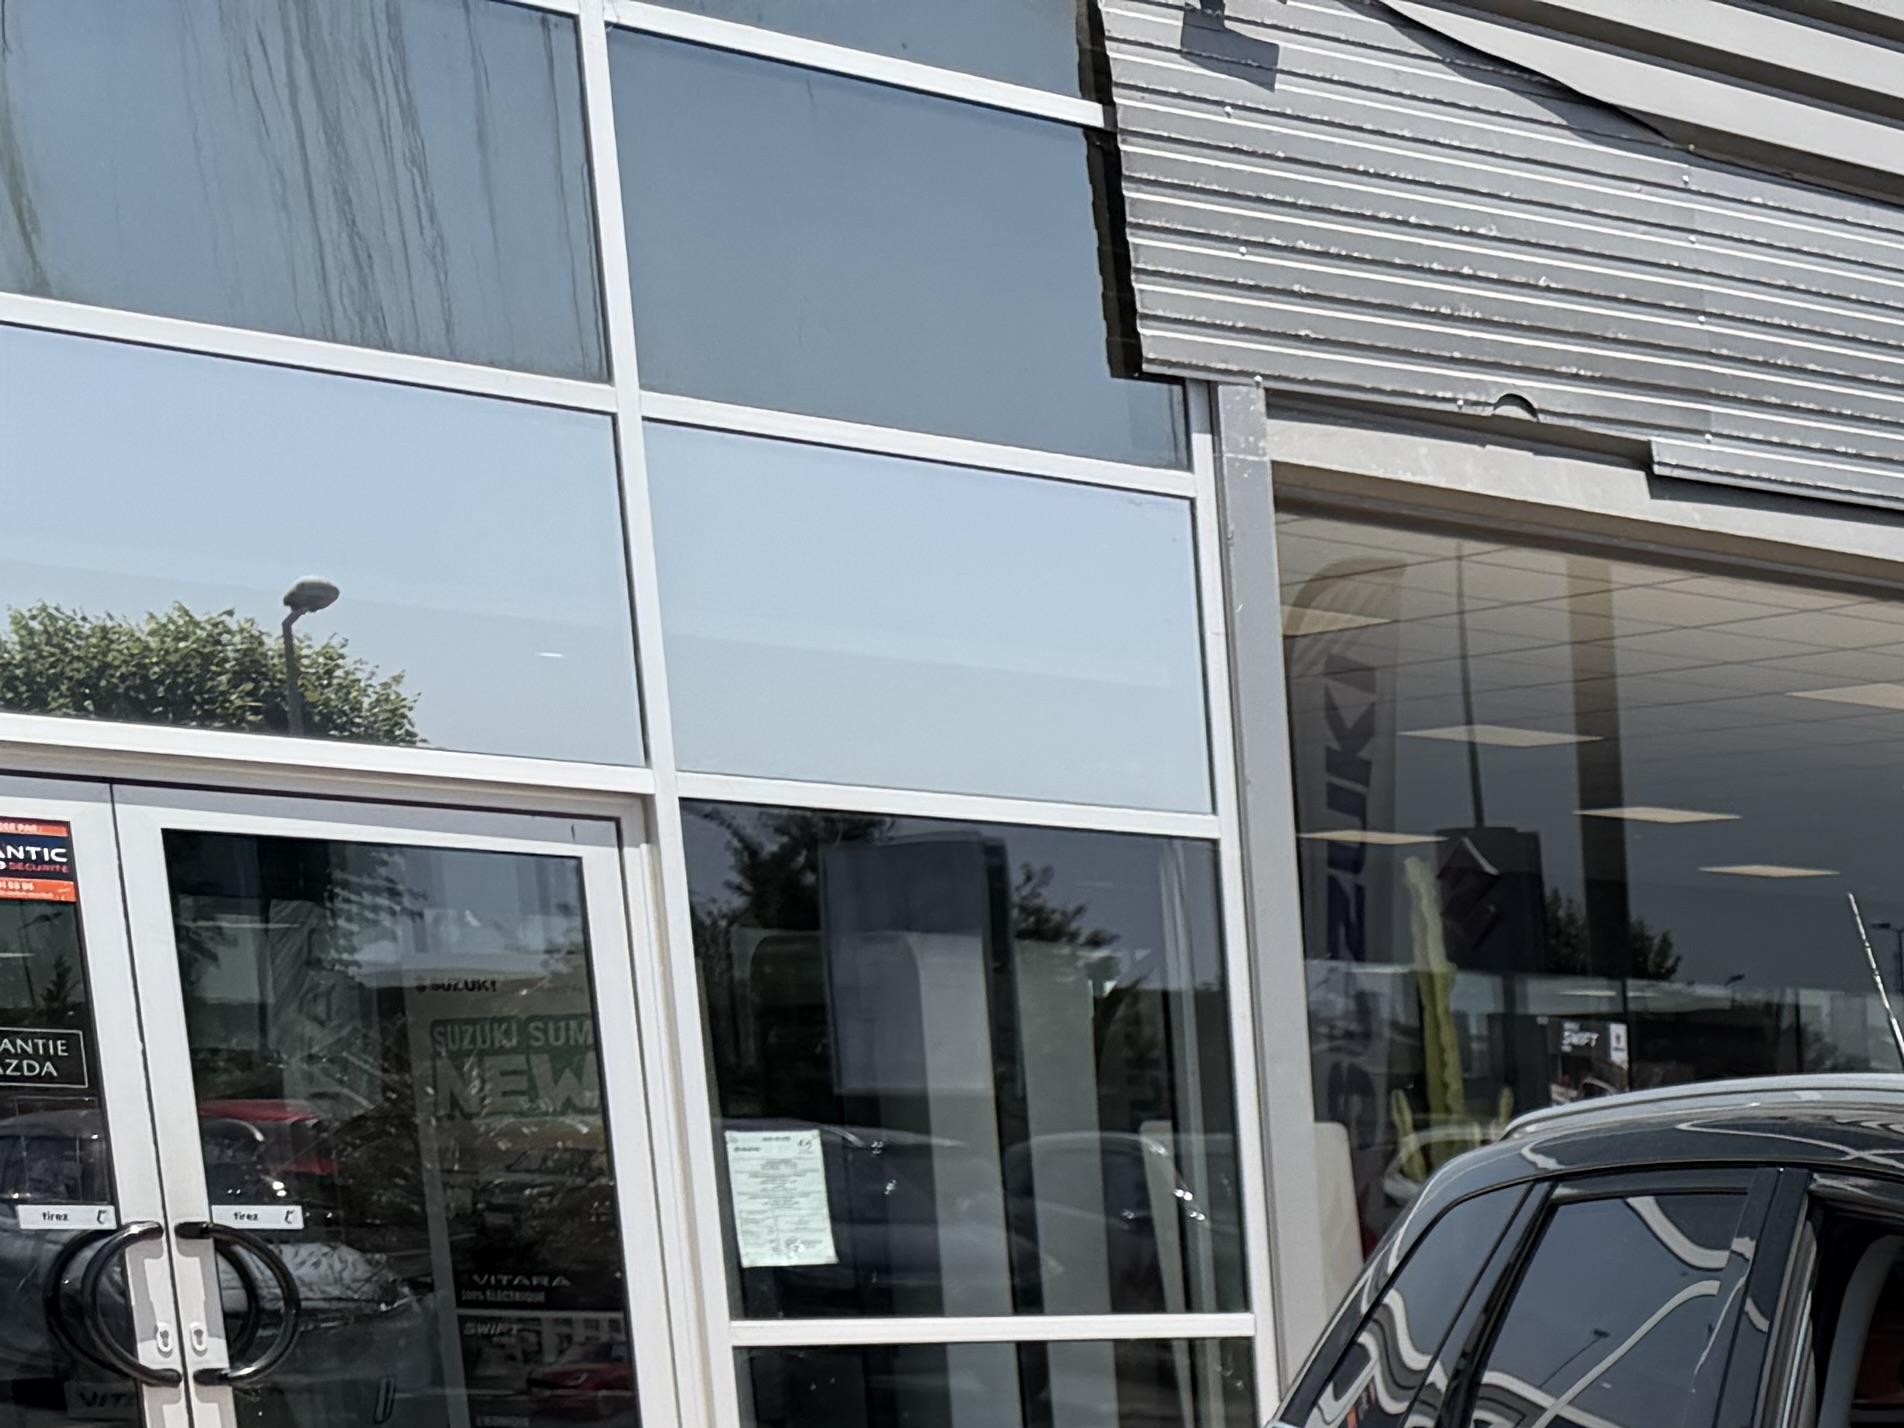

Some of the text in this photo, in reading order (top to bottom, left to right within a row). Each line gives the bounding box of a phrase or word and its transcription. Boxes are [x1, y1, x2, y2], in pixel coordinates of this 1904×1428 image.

[433, 1020, 517, 1050] SUZUKI
[41, 1211, 69, 1221] tirez
[233, 1211, 259, 1221] tirez
